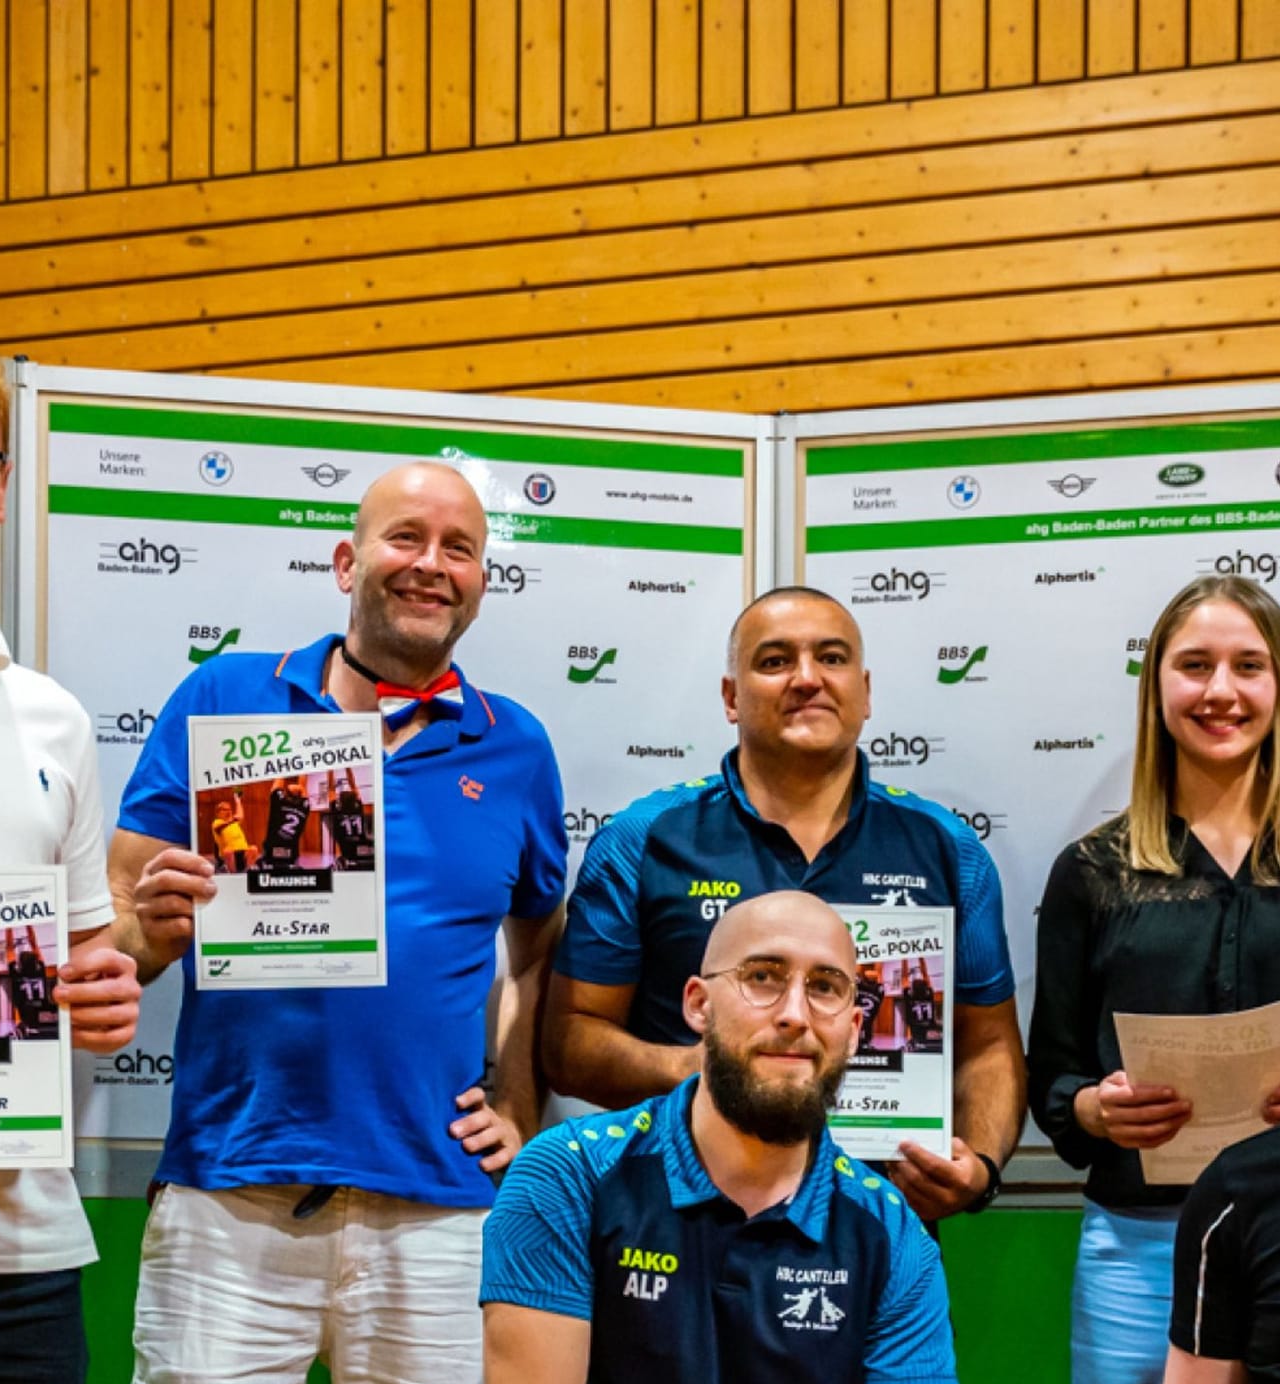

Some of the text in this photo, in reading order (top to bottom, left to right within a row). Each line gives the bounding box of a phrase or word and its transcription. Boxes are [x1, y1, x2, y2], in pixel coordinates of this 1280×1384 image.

[99, 449, 141, 463] Unsere
[605, 487, 694, 504] www.ahg-mobile.de
[853, 485, 892, 499] Unsere
[279, 509, 304, 525] ahg
[1025, 523, 1050, 537] ahg
[1052, 517, 1137, 535] Baden-Baden
[1138, 515, 1186, 530] Partner
[1188, 512, 1212, 527] des
[118, 537, 181, 575] ahg
[97, 562, 163, 576] Baden-Baden
[1214, 549, 1277, 583] ahg
[870, 567, 931, 600] ahg
[1034, 569, 1096, 586] Alphartis
[628, 580, 687, 595] Alphartis
[851, 593, 913, 605] Baden-Baden
[188, 624, 221, 640] BBS
[567, 645, 599, 660] BBS
[937, 646, 969, 660] BBS
[221, 730, 293, 763] 2022
[626, 744, 685, 759] Alphartis
[870, 732, 929, 765] ahg
[1033, 736, 1095, 753] Alphartis
[203, 745, 372, 785] 1. INT. AHG-POKAL
[688, 880, 741, 898] JAKO
[700, 898, 729, 920] GT
[93, 1075, 159, 1086] Baden-Baden
[618, 1247, 679, 1274] JAKO
[623, 1272, 669, 1300] ALP
